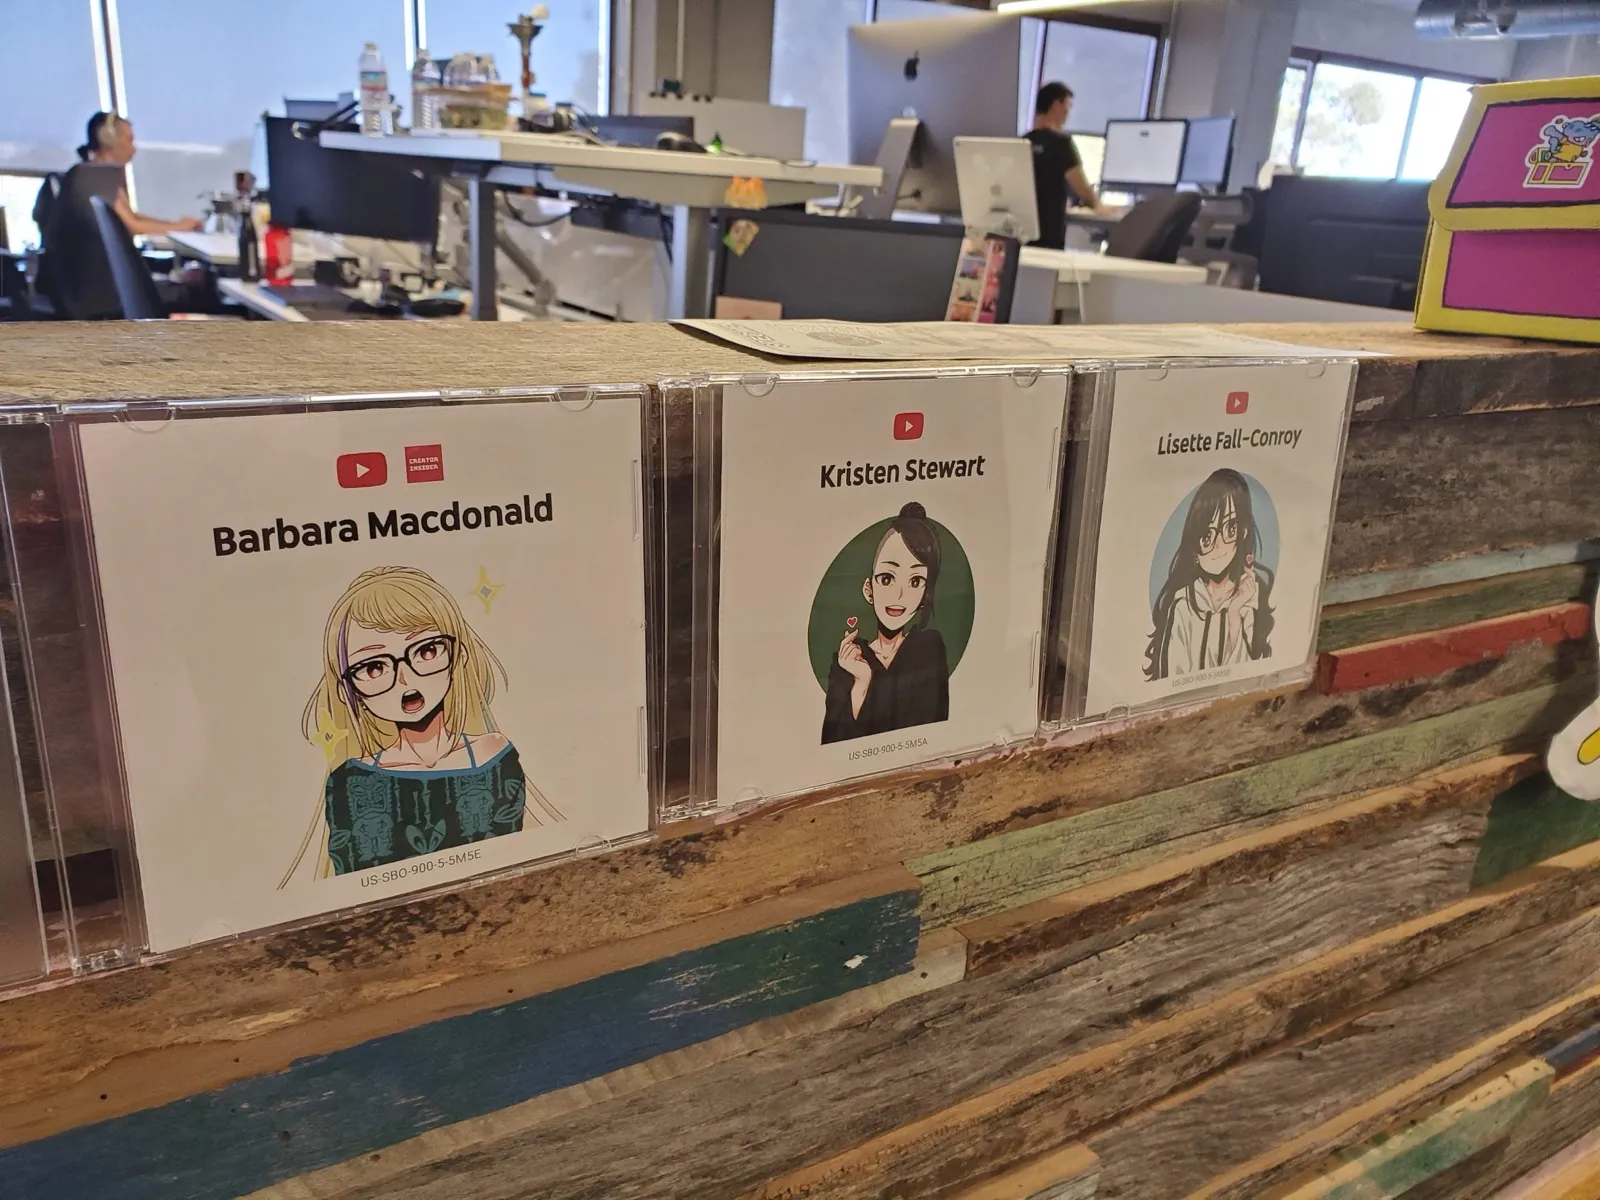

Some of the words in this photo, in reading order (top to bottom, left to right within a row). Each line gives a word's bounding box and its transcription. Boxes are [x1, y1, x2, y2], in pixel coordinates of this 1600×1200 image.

[1157, 432, 1212, 455] Lisette
[1215, 428, 1303, 451] Fall-Conroy
[409, 456, 439, 465] CREATOR
[409, 464, 439, 472] INSIDER
[820, 460, 900, 488] Kristen
[904, 455, 986, 482] Stewart
[212, 518, 359, 557] Barbara
[367, 492, 554, 540] Macdonald
[848, 737, 928, 761] US-SBO-900-5-5M5A
[360, 848, 482, 888] US-SBO-900-5-5M5E
